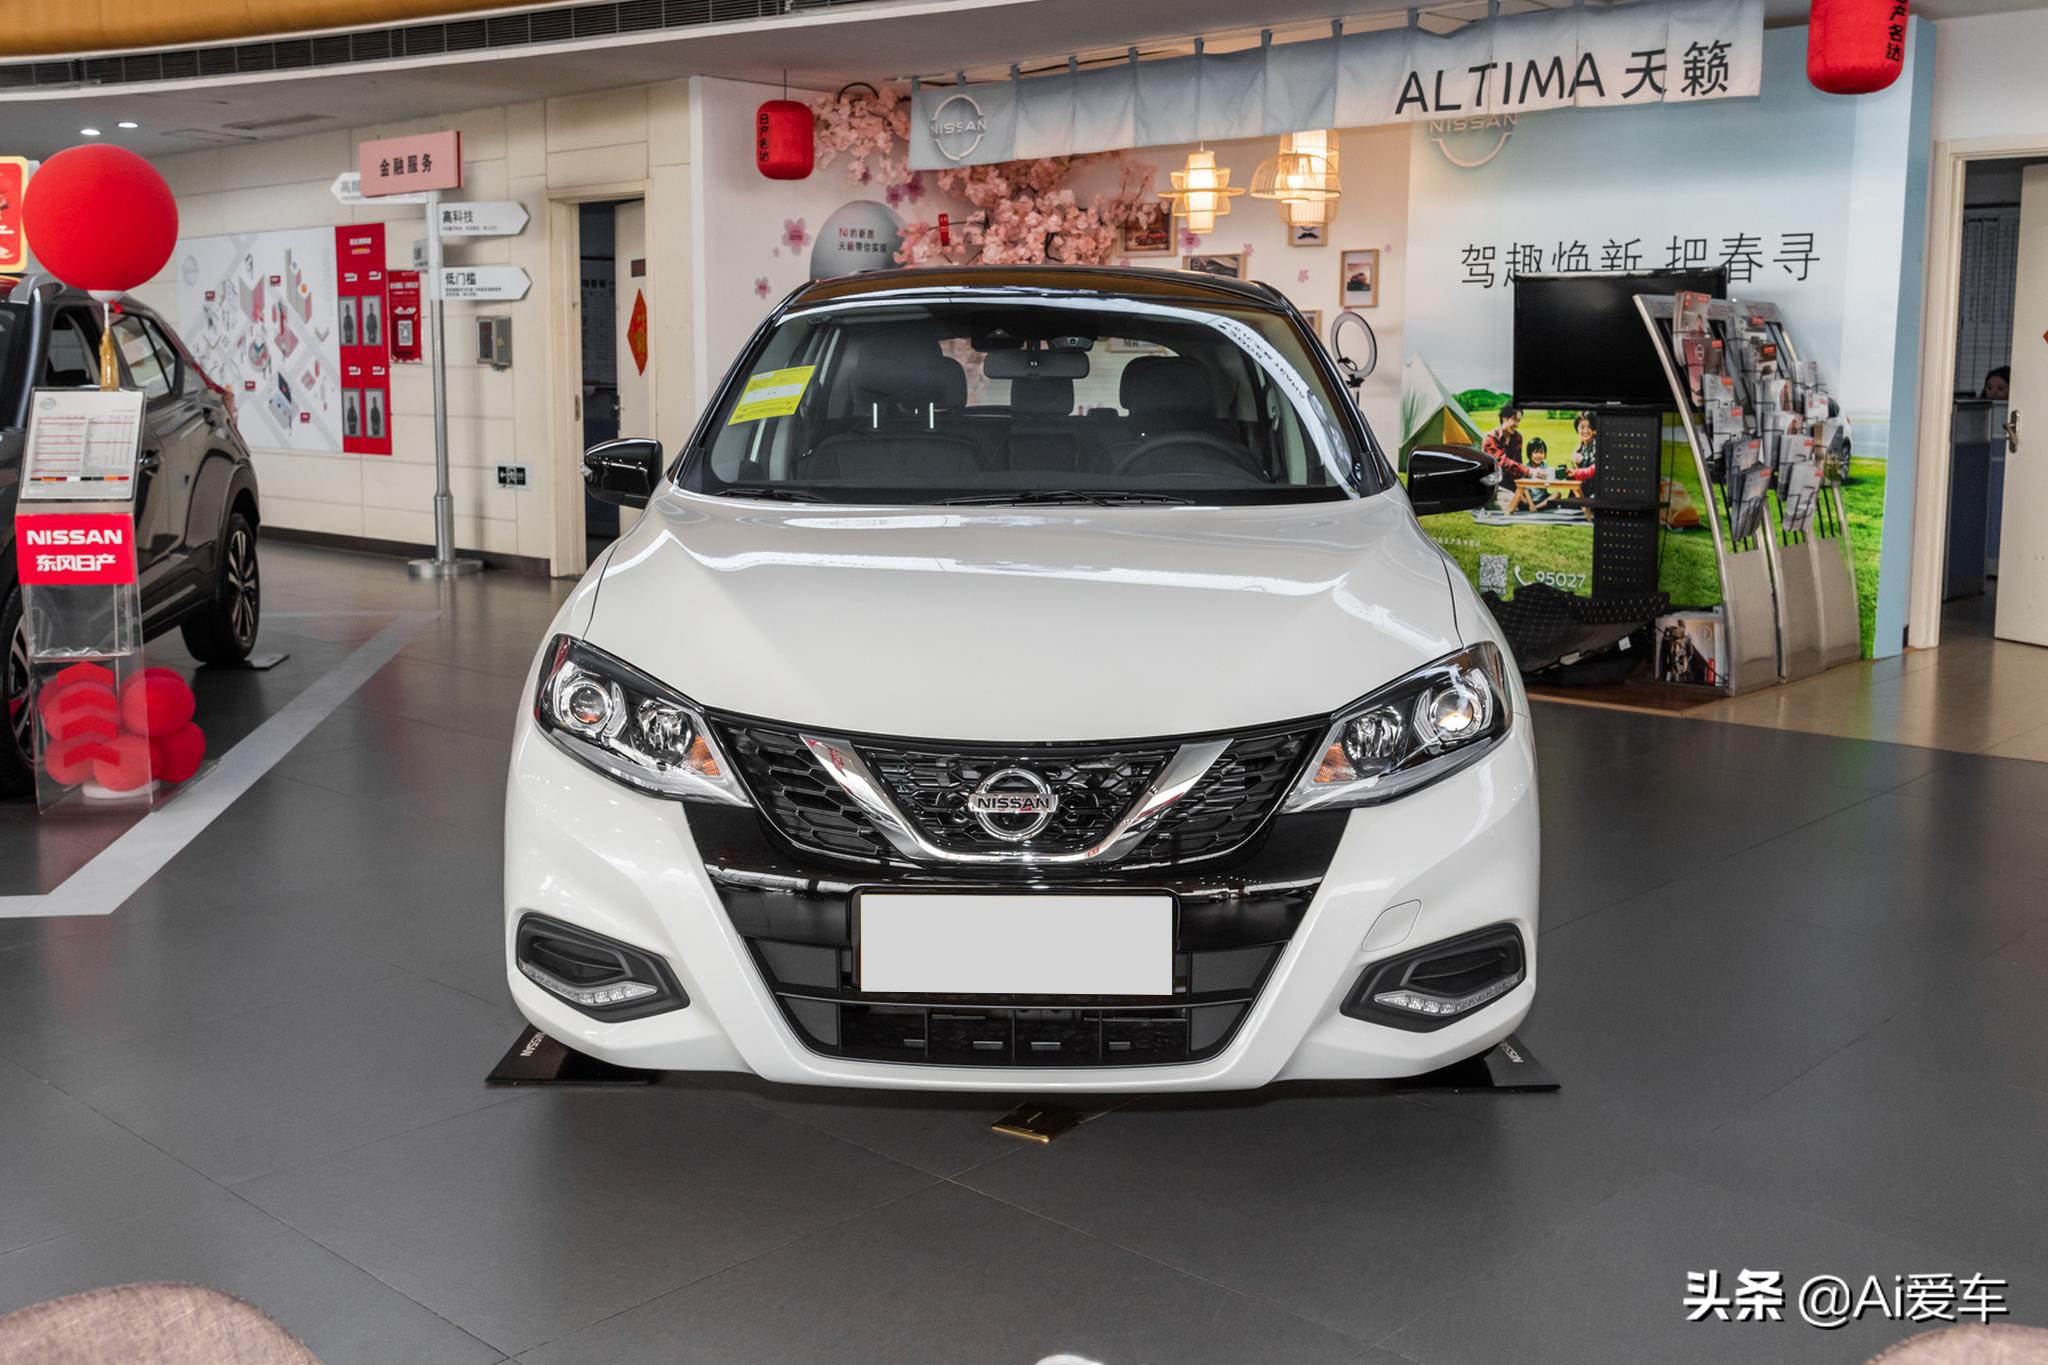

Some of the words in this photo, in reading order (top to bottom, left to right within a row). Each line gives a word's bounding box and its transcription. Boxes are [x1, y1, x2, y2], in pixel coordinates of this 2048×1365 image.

[1395, 52, 1606, 115] ALTIMA
[1621, 40, 1733, 98] 天籁
[931, 118, 988, 135] NISSAN
[1428, 112, 1519, 133] NISSAN
[379, 153, 433, 177] 金融服务
[442, 209, 474, 224] 高科技
[445, 271, 477, 286] 低门槛
[26, 529, 123, 545] NISSAN
[35, 553, 116, 572] 东风日产
[1535, 571, 1586, 588] 95027
[977, 796, 1049, 810] NISSAN
